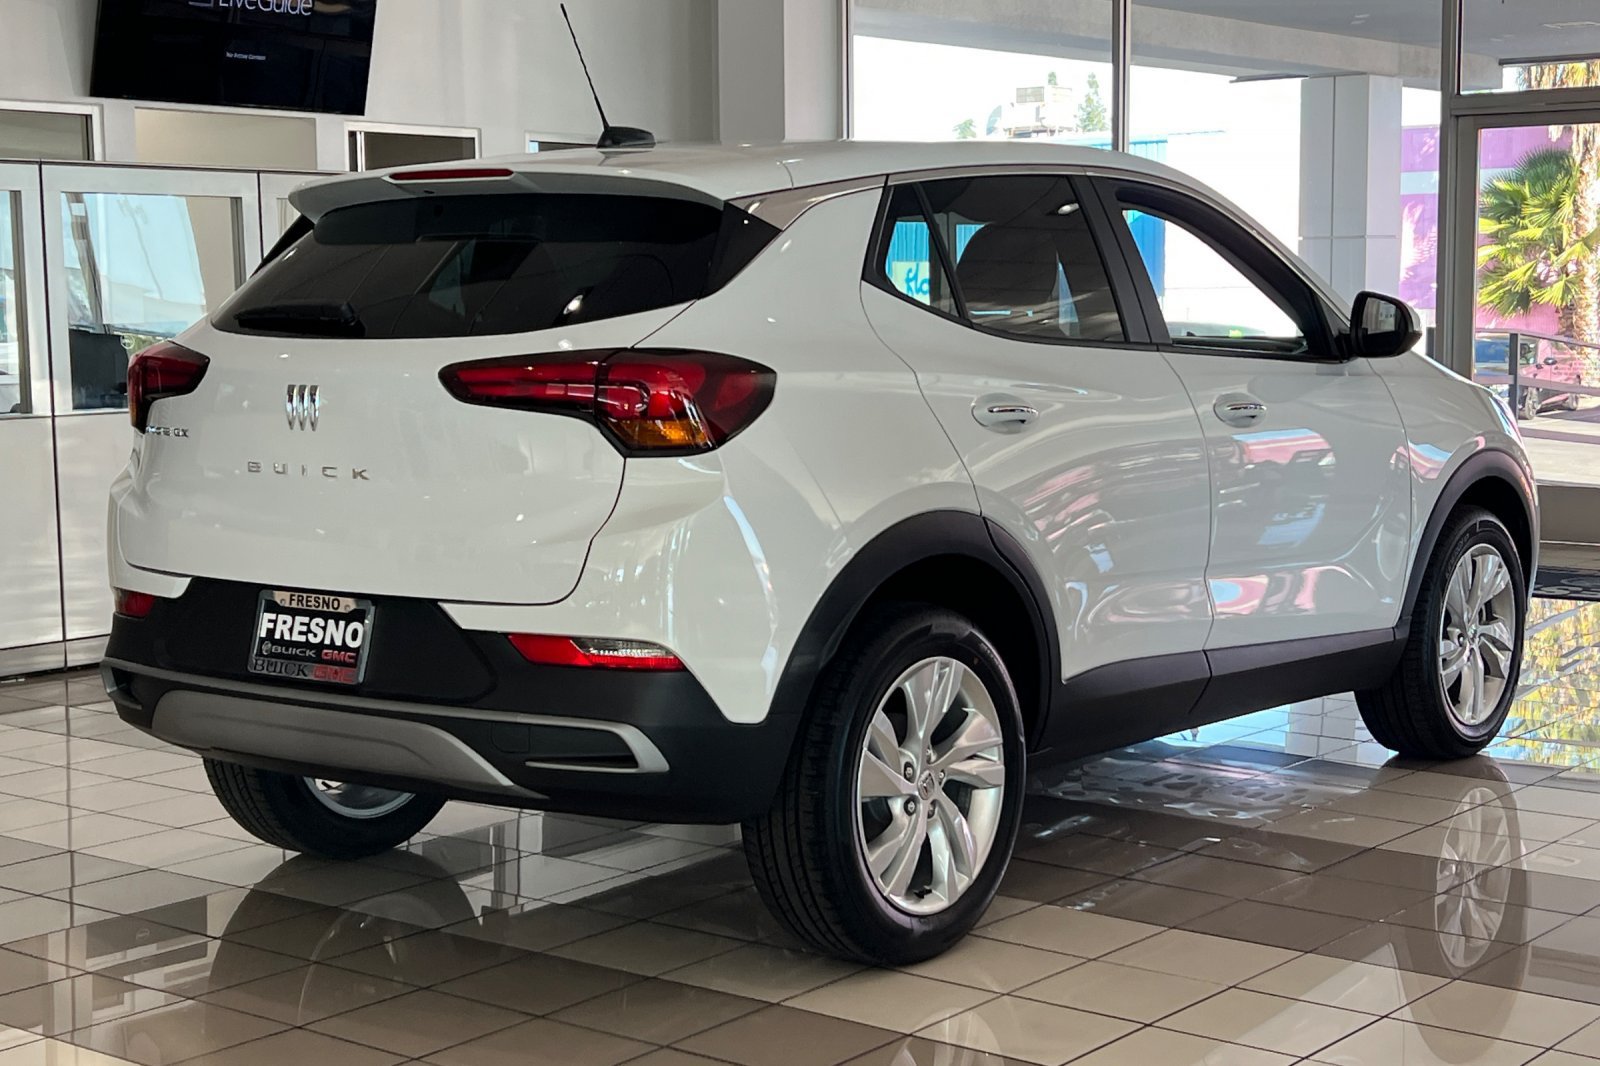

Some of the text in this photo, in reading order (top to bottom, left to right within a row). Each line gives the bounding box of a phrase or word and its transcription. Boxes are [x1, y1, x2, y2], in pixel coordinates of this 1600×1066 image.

[219, 0, 312, 15] veGuide
[247, 460, 370, 481] BUICK
[289, 593, 341, 611] FRESNO
[259, 612, 364, 649] FRESNO
[271, 645, 357, 663] BUICK GMC
[253, 659, 354, 683] BUICK GMC
